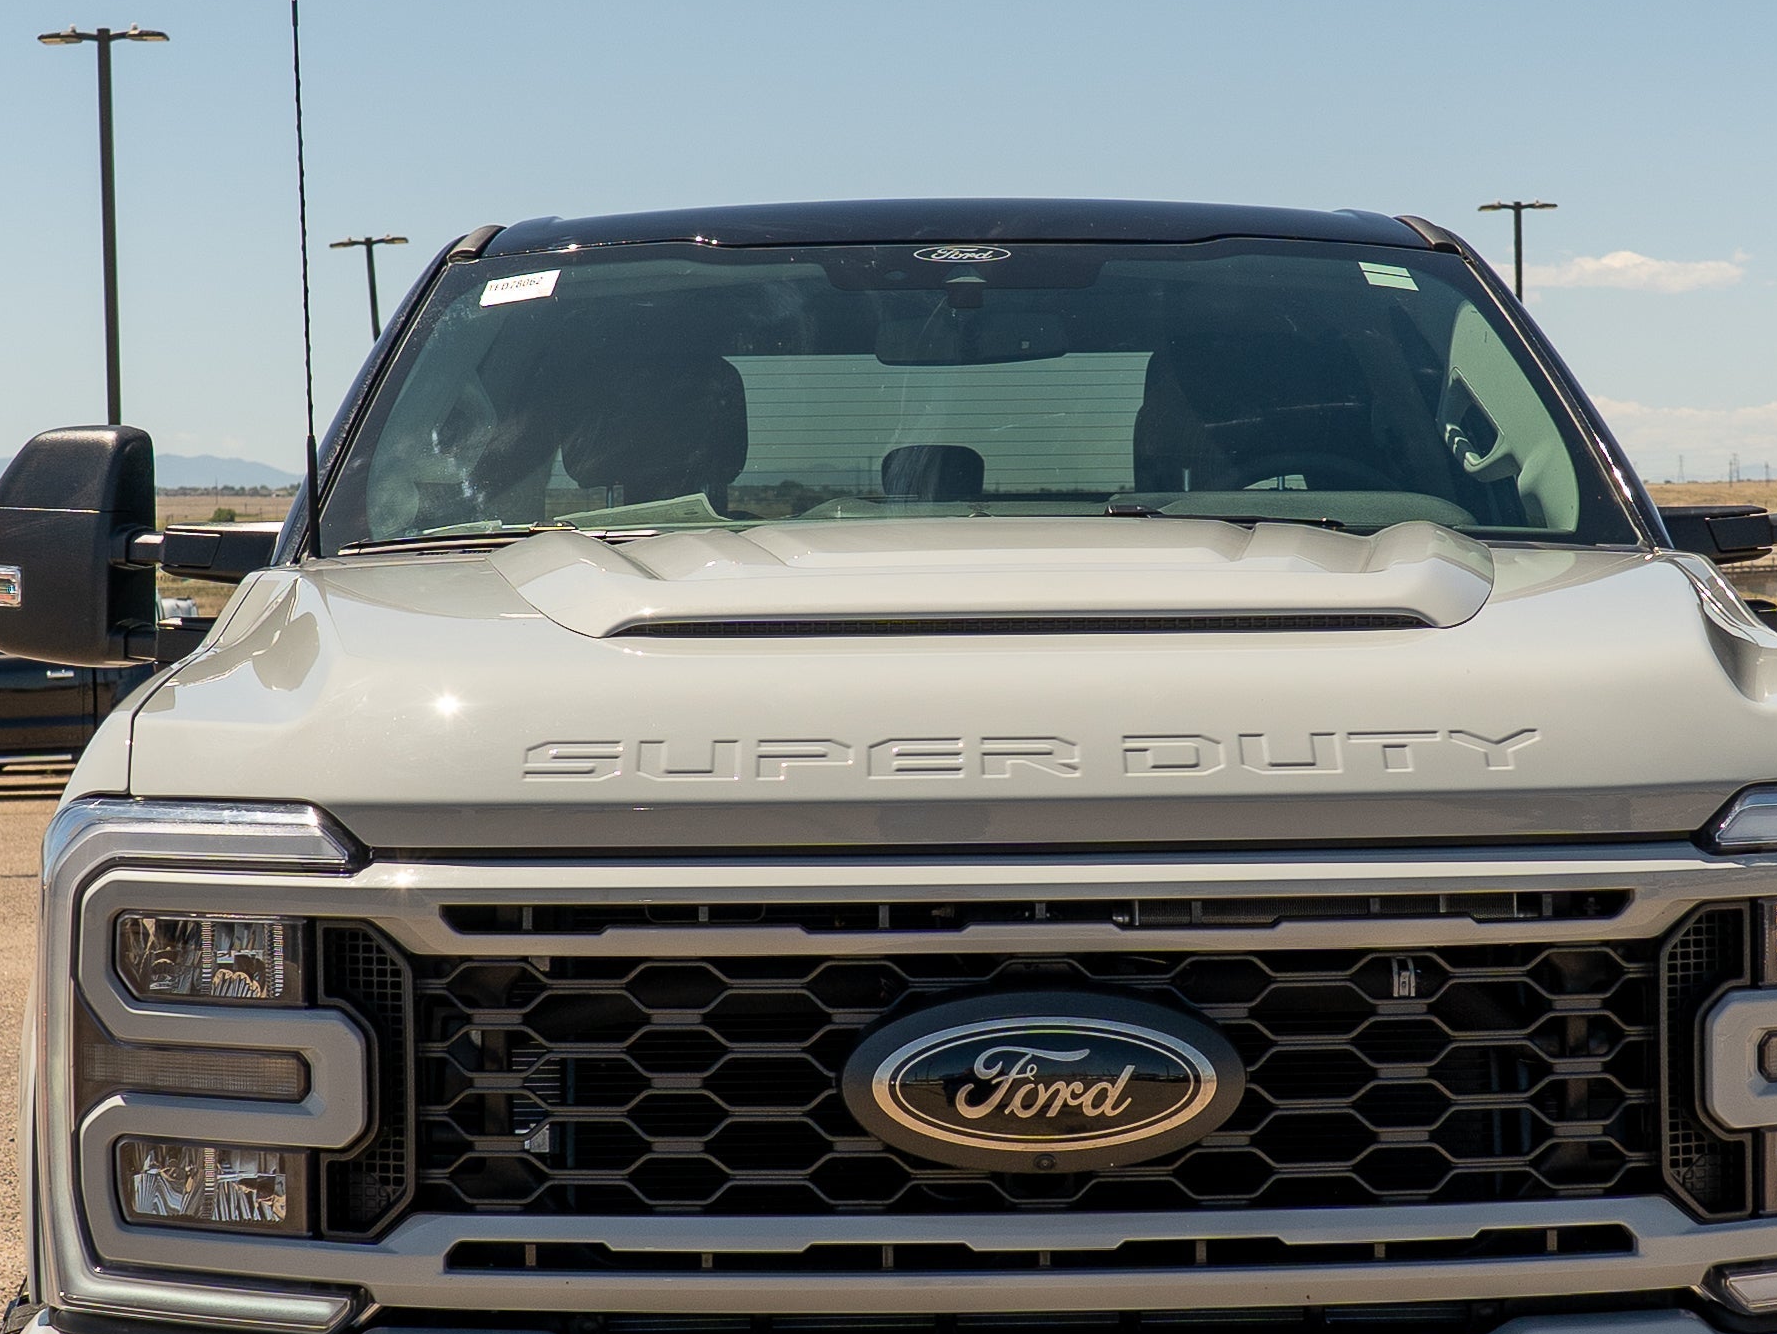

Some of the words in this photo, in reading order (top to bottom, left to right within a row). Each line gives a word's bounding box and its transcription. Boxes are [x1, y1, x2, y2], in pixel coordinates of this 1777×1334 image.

[930, 247, 994, 261] Ford
[521, 736, 1082, 783] SUPER
[1121, 727, 1541, 778] DUTY
[954, 1045, 1136, 1120] Ford
